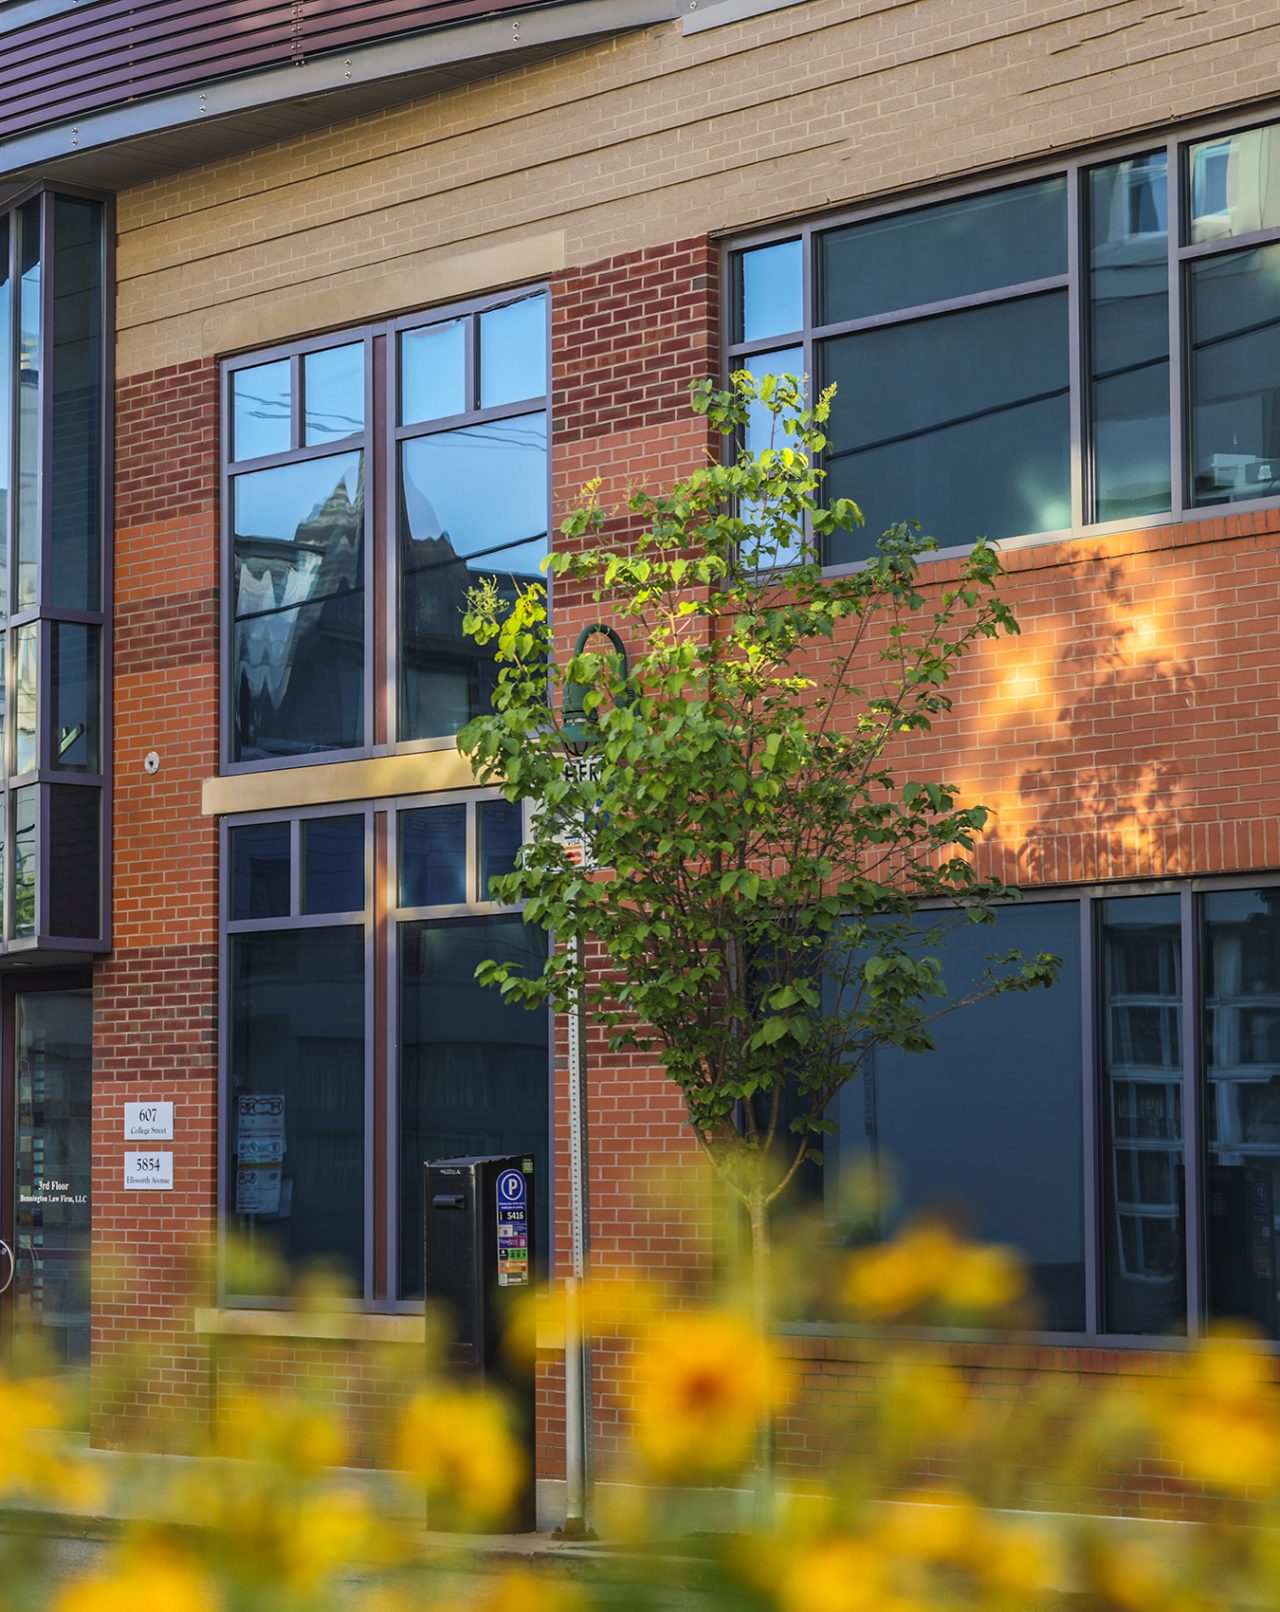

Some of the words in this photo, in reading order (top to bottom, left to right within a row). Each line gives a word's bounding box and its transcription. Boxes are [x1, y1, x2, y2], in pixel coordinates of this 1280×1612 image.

[138, 1108, 157, 1122] 607
[130, 1127, 150, 1135] College
[151, 1127, 167, 1135] Street
[136, 1158, 160, 1172] 5854
[38, 1180, 50, 1191] 3rd
[51, 1180, 69, 1191] Floor
[151, 1176, 170, 1184] Avenue
[508, 1178, 518, 1195] P
[20, 1194, 48, 1203] Bennington
[75, 1195, 88, 1203] LLC
